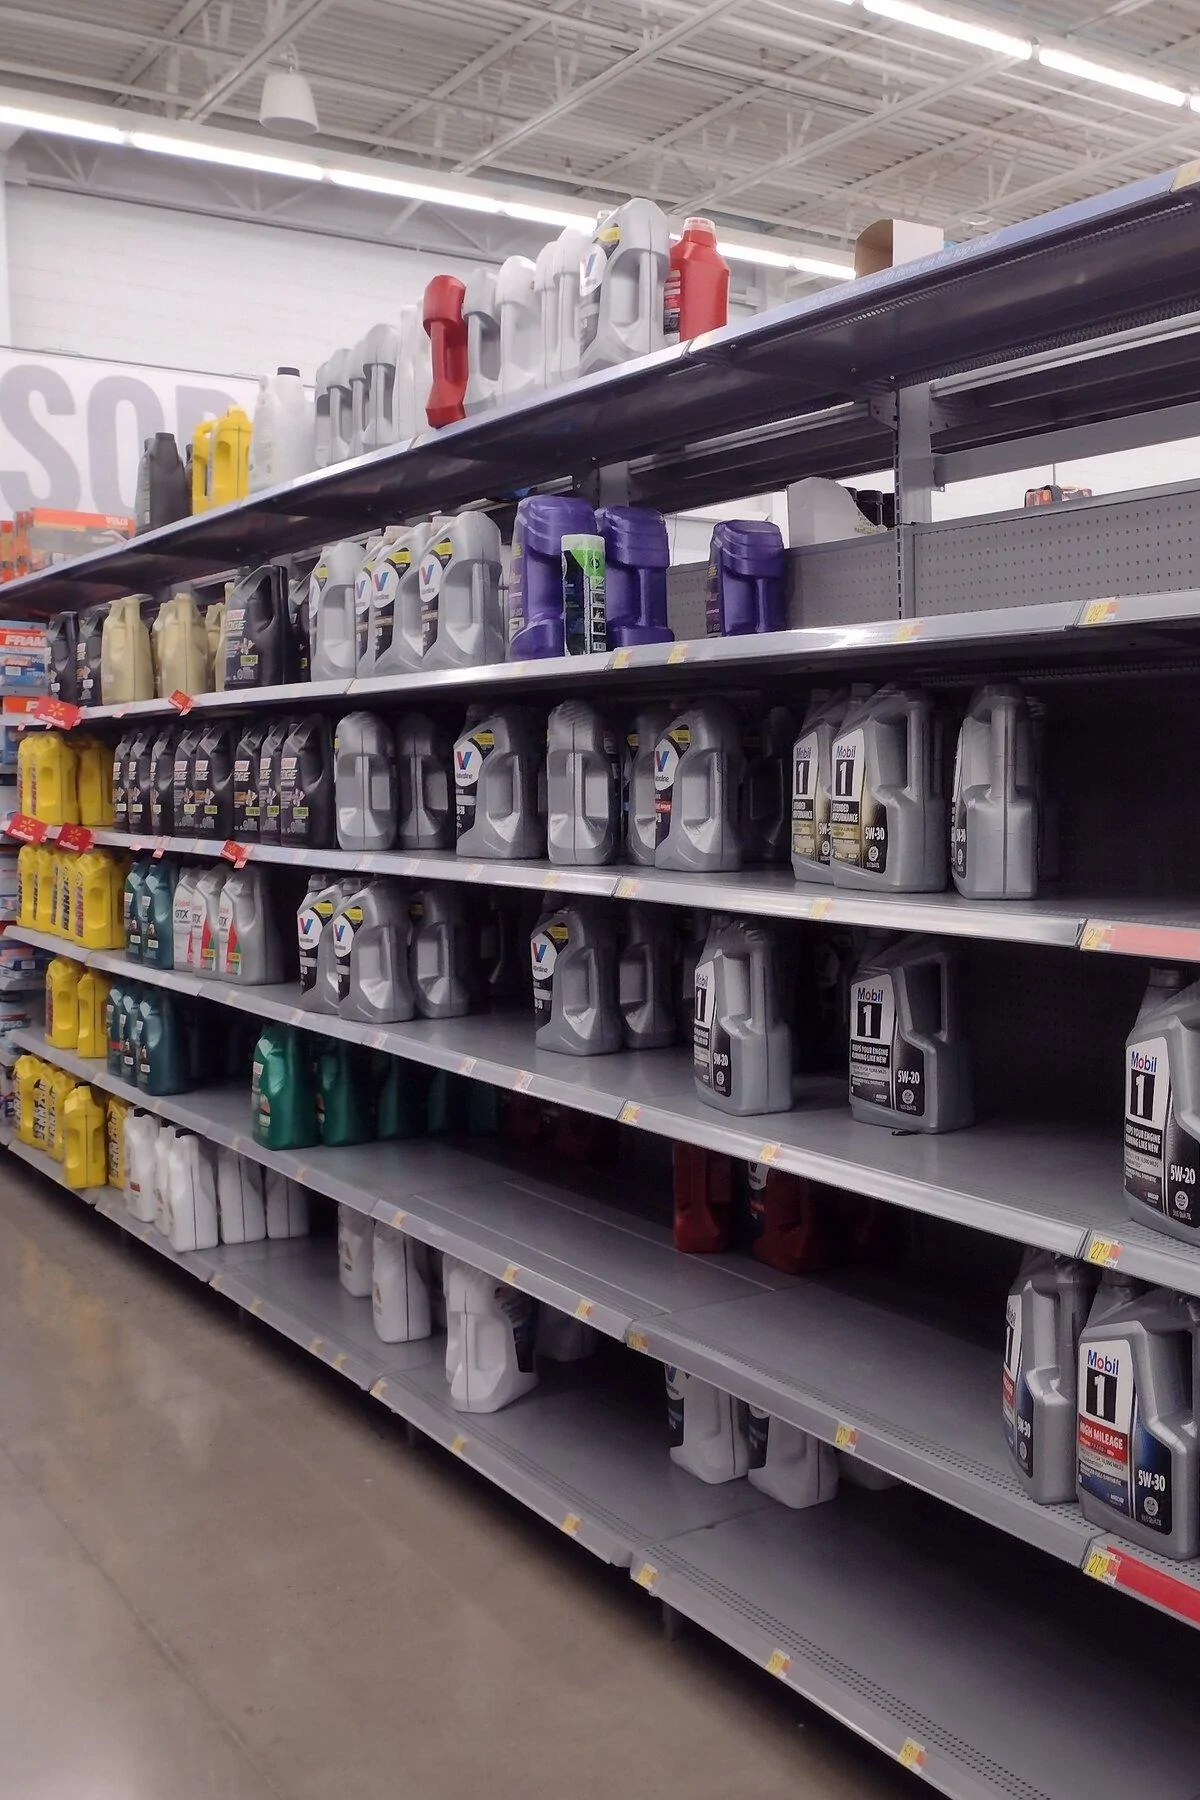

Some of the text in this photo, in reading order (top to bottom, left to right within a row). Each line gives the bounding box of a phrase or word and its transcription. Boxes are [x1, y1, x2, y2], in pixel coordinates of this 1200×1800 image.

[797, 747, 811, 759] Mobil
[837, 746, 856, 758] Mobil
[798, 763, 804, 794] 1
[840, 762, 847, 795] 1
[865, 826, 884, 840] 5W-30
[857, 987, 883, 1001] Mobil
[863, 1004, 873, 1036] 1
[1131, 1051, 1157, 1072] Mobil
[897, 1071, 920, 1084] 5W-20
[1135, 1074, 1145, 1116] 1
[1170, 1165, 1195, 1185] 5W-20
[1088, 1350, 1119, 1375] Mobil
[1094, 1375, 1105, 1418] 1
[1079, 1422, 1092, 1440] HIGH
[1094, 1428, 1123, 1450] MILEAGE
[1138, 1469, 1166, 1491] 5W-30
